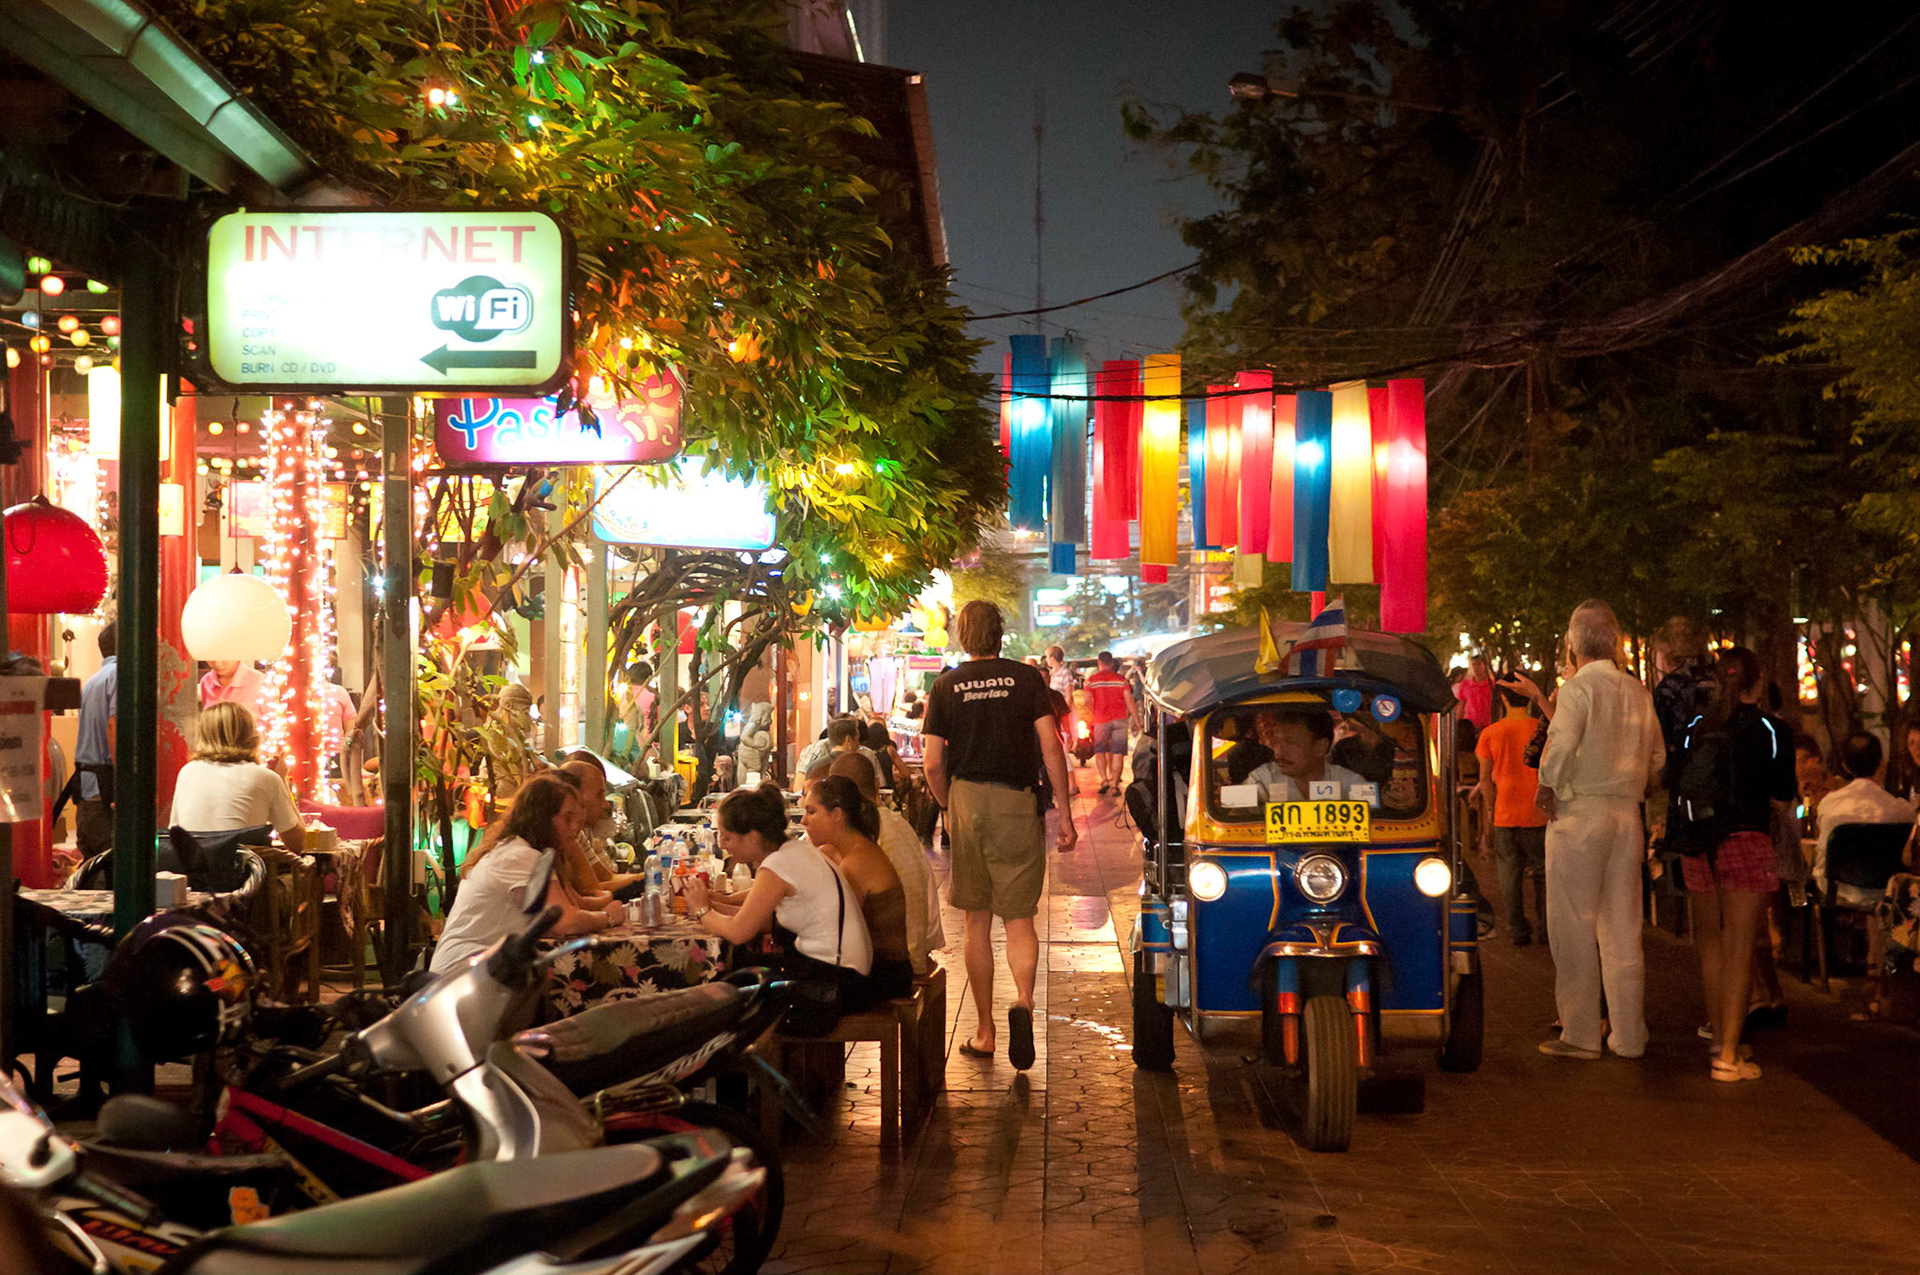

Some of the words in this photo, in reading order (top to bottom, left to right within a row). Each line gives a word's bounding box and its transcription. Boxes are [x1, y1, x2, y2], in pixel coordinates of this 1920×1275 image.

[242, 345, 276, 356] SCAN
[241, 363, 275, 374] BURN
[310, 362, 336, 373] DVD
[962, 688, 1010, 703] Beerlao
[1313, 803, 1365, 824] 1893
